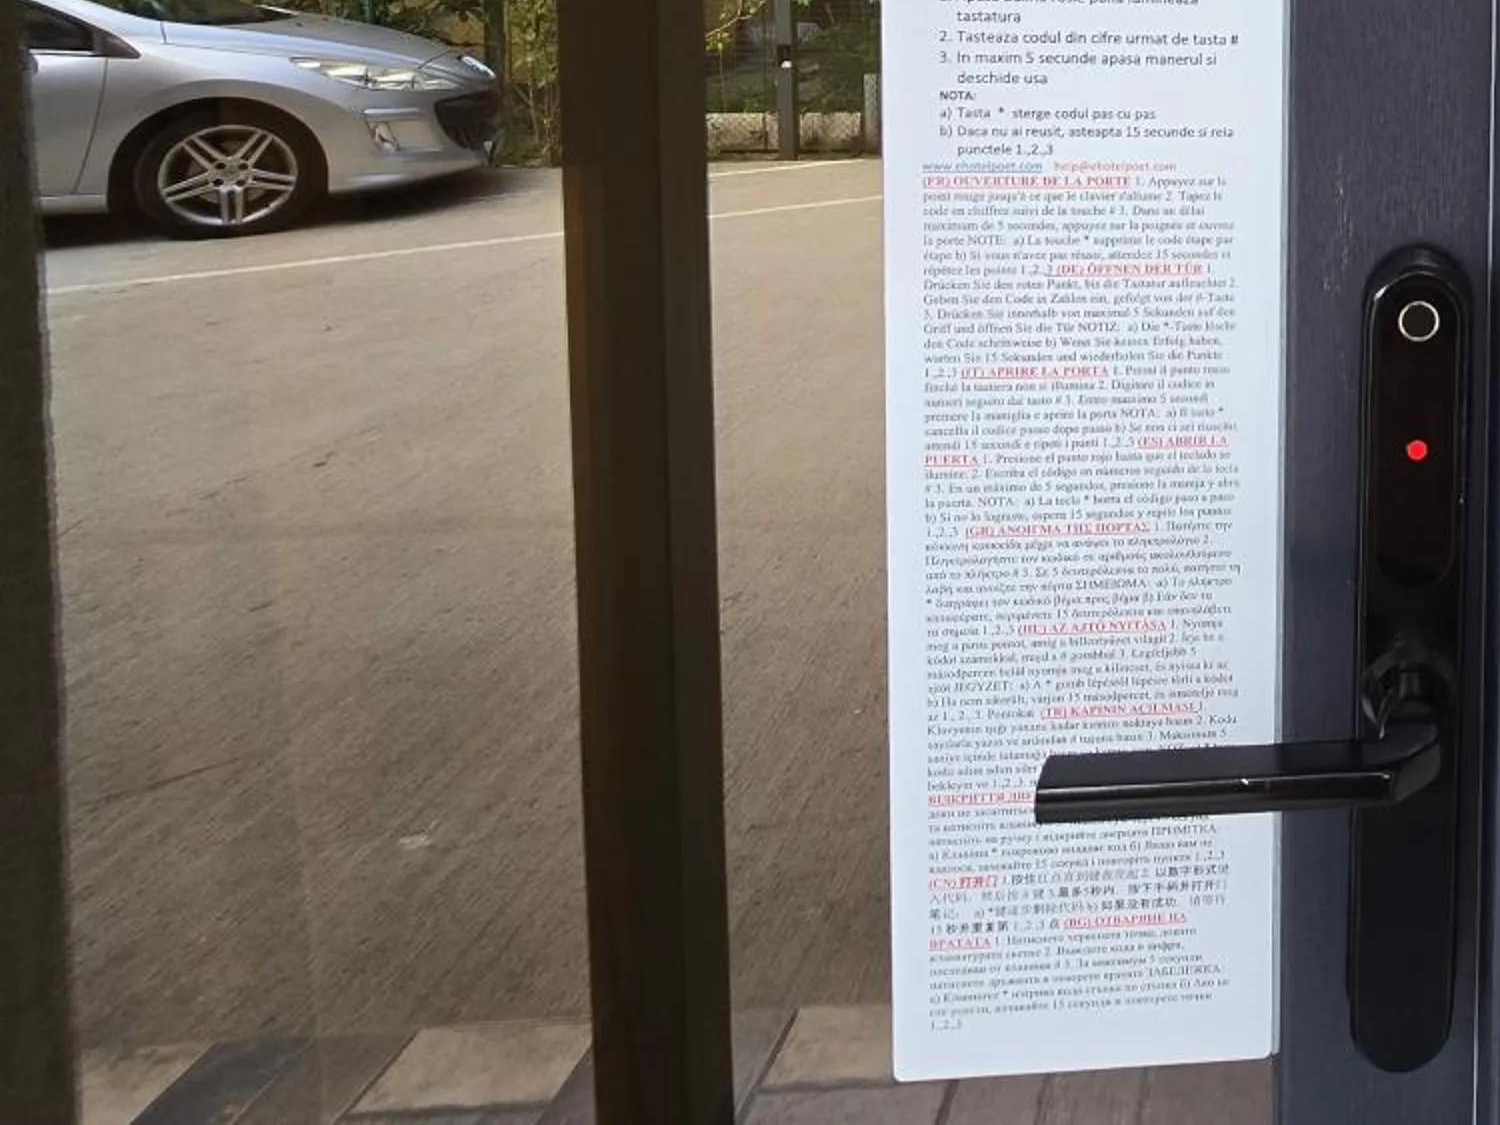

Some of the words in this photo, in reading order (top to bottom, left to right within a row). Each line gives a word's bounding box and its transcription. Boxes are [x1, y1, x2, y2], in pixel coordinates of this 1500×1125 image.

[956, 10, 1021, 22] tastatura
[939, 30, 951, 41] 2.
[956, 30, 1018, 42] Tasteaza
[1023, 31, 1061, 43] codul
[1065, 32, 1086, 43] din
[1091, 32, 1121, 43] cifre
[1125, 33, 1167, 44] urmat
[1171, 33, 1188, 44] de
[1193, 33, 1226, 45] tasta
[1230, 34, 1238, 45] #
[939, 51, 951, 62] 3.
[957, 51, 970, 62] In
[975, 51, 1020, 63] maxim
[1025, 52, 1033, 63] 5
[1039, 52, 1097, 64] secunde
[1101, 56, 1140, 67] apasa
[1145, 53, 1202, 65] manerul
[1206, 54, 1216, 65] si
[957, 72, 1019, 83] deschide
[1024, 75, 1047, 84] usa
[939, 91, 975, 99] NOTA:
[939, 108, 952, 119] a)
[957, 108, 990, 118] Tasta
[1011, 108, 1050, 121] sterge
[1054, 108, 1088, 118] codul
[1091, 112, 1115, 121] pas
[1135, 112, 1155, 122] pas
[940, 126, 952, 137] b)
[957, 126, 987, 136] Daca
[1011, 126, 1022, 136] ai
[1068, 126, 1122, 139] asteapta
[1126, 127, 1139, 136] 15
[1143, 127, 1194, 137] secunde
[1210, 127, 1233, 137] reia
[957, 144, 1012, 157] punctele
